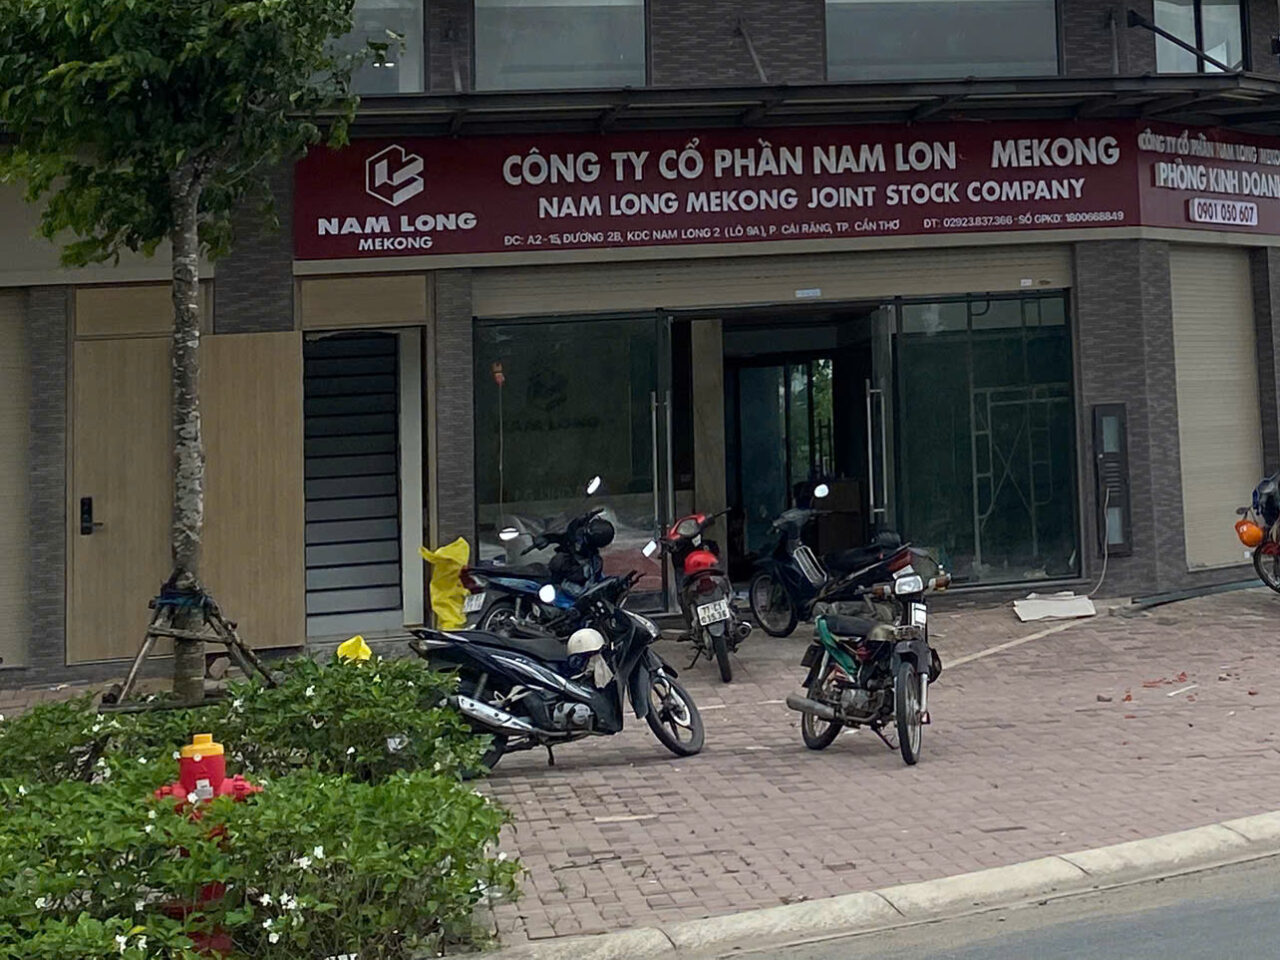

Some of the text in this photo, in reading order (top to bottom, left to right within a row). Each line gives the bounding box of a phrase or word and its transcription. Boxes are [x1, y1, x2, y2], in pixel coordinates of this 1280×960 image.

[1138, 128, 1166, 153] CÔNG
[1166, 136, 1177, 154] TY
[1178, 129, 1189, 155] CỔ
[502, 136, 1121, 186] CÔNG TY CỔ PHẦN NAM LON MEKONG
[1157, 158, 1207, 191] PHÒNG
[1209, 168, 1239, 195] KINH
[538, 178, 1086, 219] NAM LONG MEKONG JOINT STOCK COMPANY
[318, 212, 478, 236] NAM LONG
[1197, 202, 1254, 223] 0901 050 607
[627, 230, 650, 241] KDC
[652, 229, 678, 240] NAM
[682, 228, 711, 239] LONG
[714, 228, 720, 237] 2
[878, 219, 900, 231] THƠ
[358, 236, 433, 252] MEKONG
